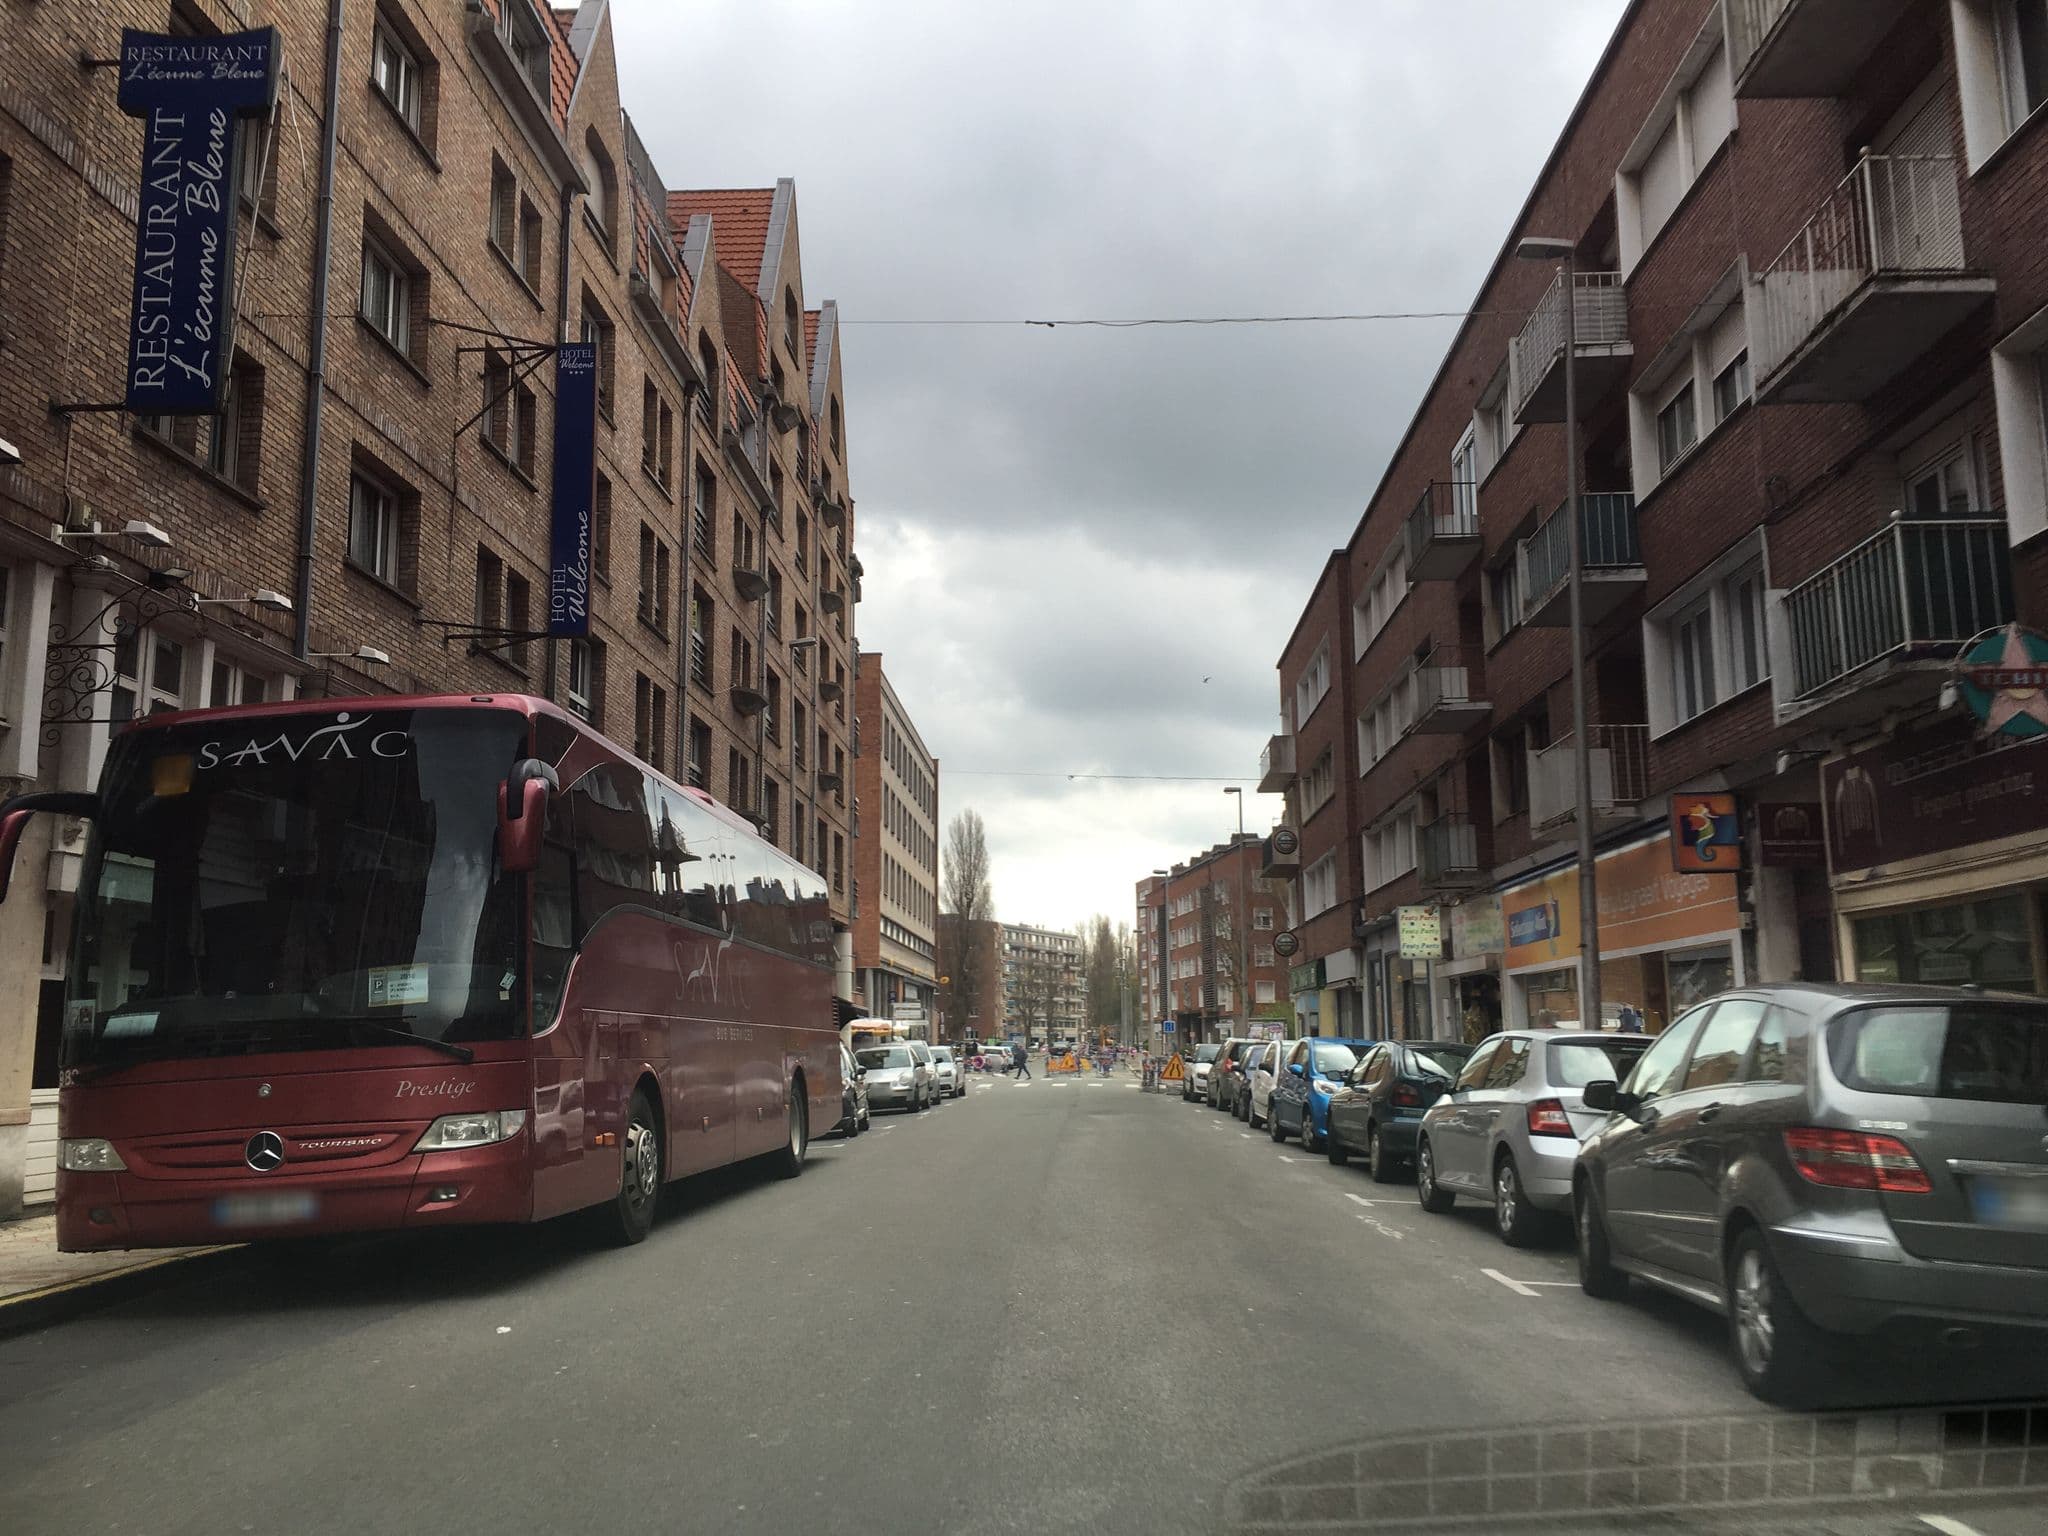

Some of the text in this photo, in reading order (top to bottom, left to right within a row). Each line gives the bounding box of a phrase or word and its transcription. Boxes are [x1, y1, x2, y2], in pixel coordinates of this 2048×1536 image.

[127, 46, 267, 62] RESTAURANT
[211, 60, 265, 80] Bleue
[185, 107, 227, 216] Bleue
[134, 106, 185, 390] RESTAURANT
[559, 357, 594, 369] Welcome
[560, 349, 594, 358] HOTEL
[566, 510, 588, 622] Welcome
[551, 563, 566, 622] HOTEL
[197, 712, 408, 770] SAVAC
[394, 1077, 476, 1099] Prestige
[299, 1138, 382, 1149] TOURISMO
